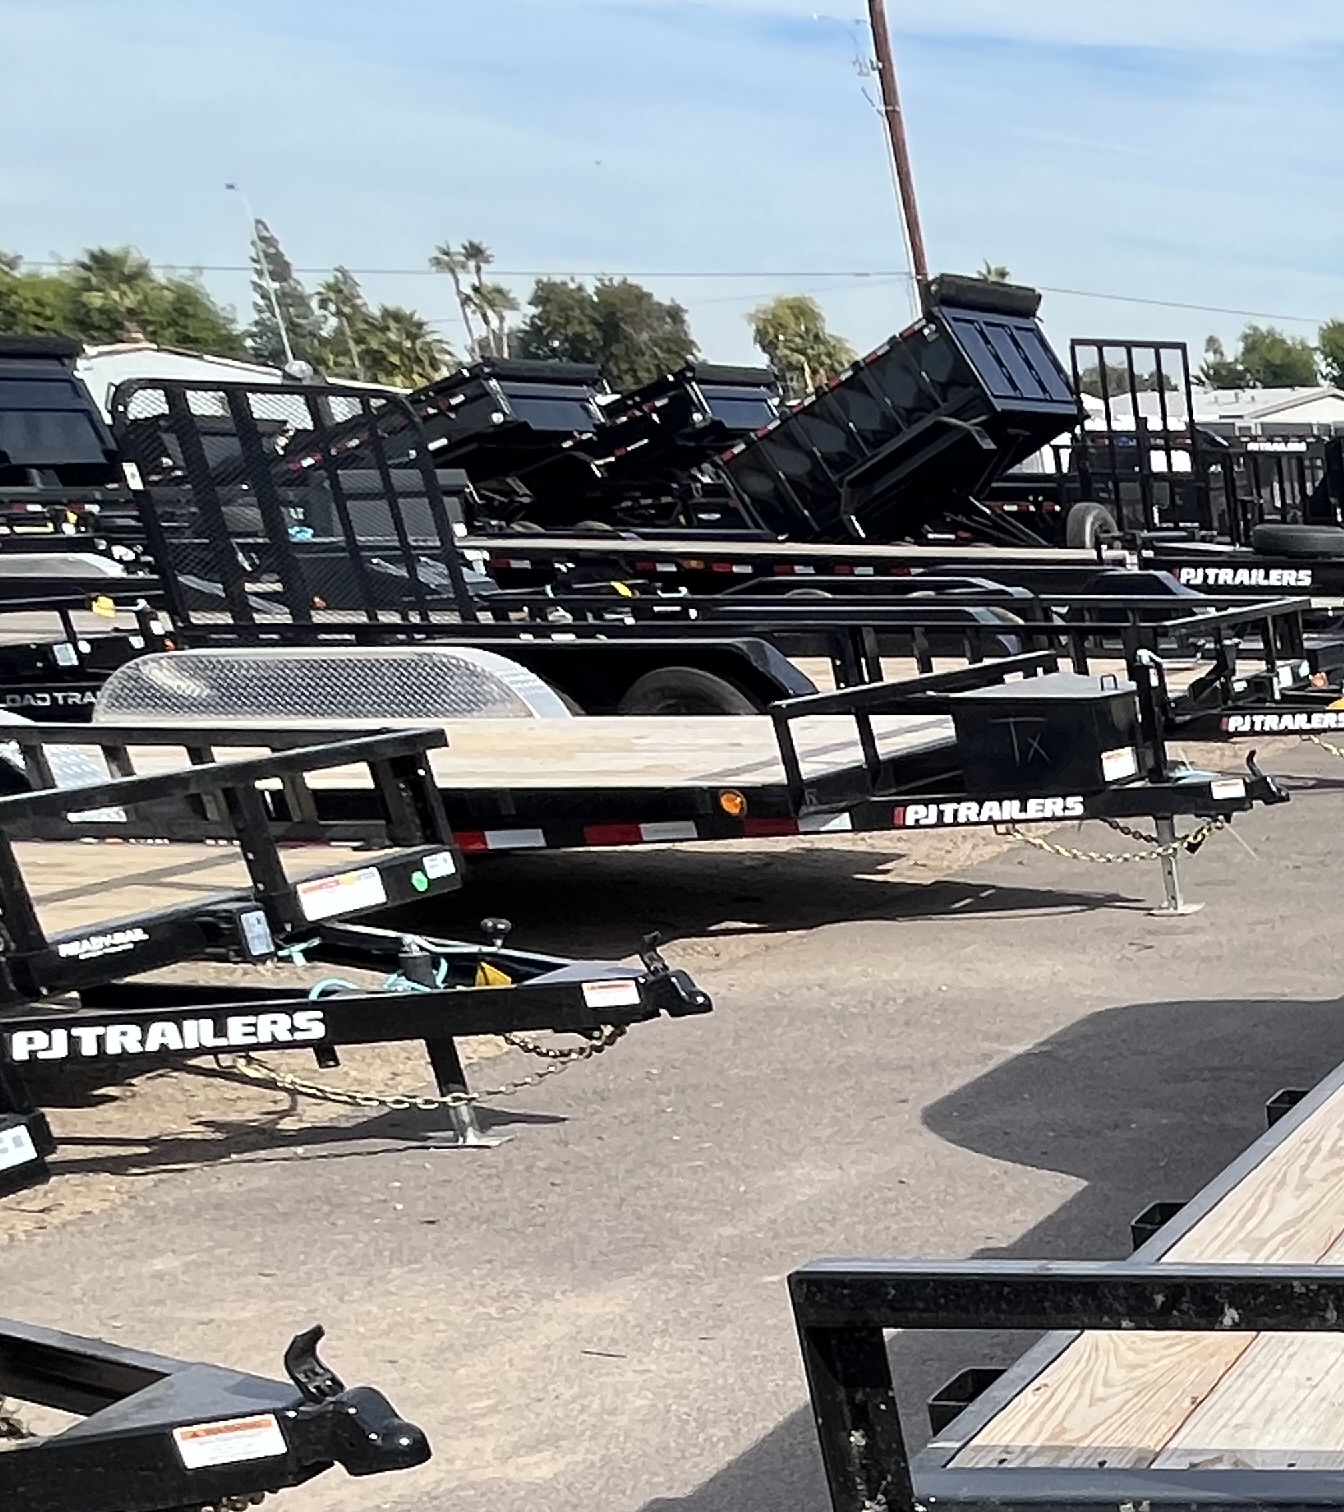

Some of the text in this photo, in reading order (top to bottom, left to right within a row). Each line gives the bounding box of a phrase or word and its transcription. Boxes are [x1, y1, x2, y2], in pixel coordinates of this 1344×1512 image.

[1205, 568, 1312, 586] TRAILERS
[939, 796, 1084, 824] TRAILERS
[71, 1010, 326, 1057] TRAILERS
